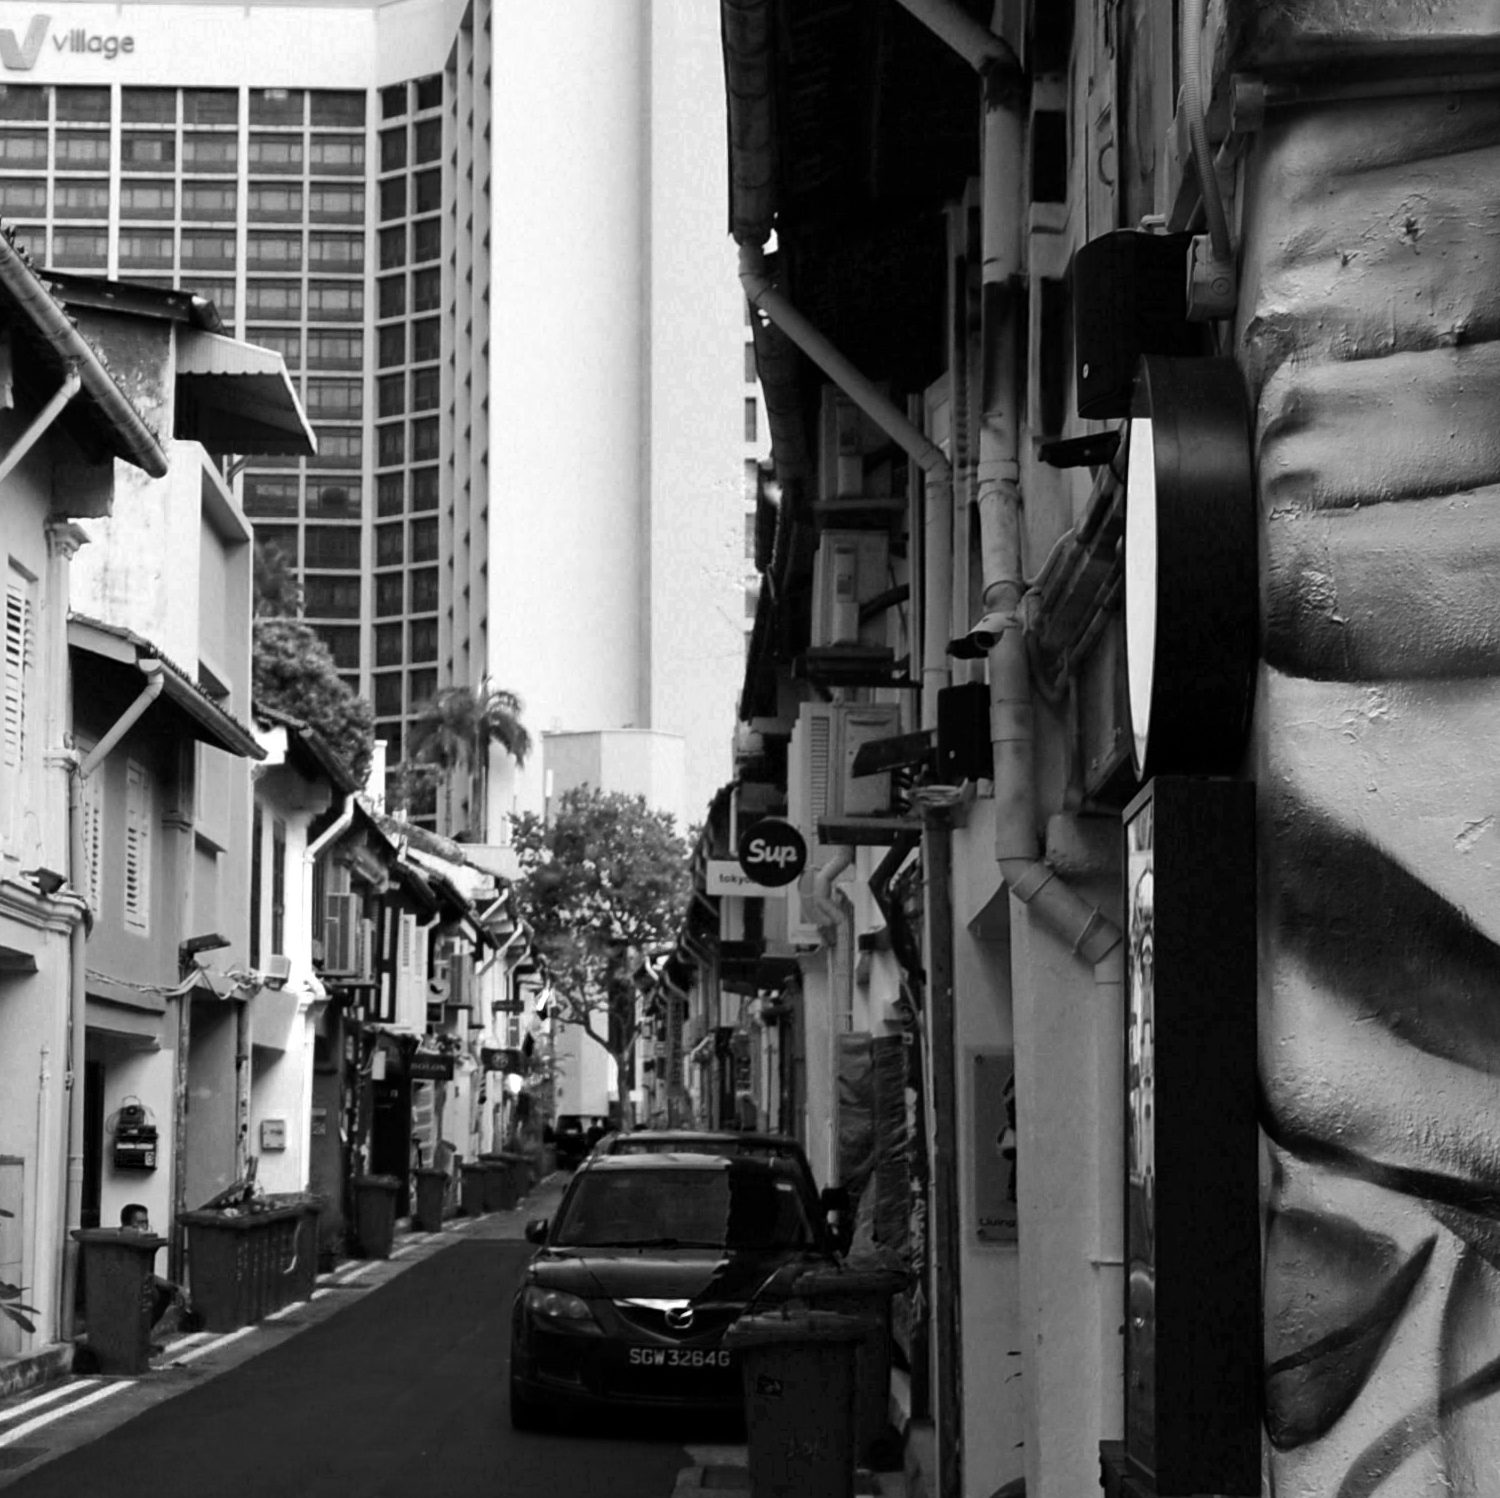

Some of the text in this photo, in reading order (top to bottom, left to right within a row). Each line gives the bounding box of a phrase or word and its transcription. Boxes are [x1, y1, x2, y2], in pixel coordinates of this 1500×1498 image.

[52, 29, 135, 60] village
[746, 838, 798, 869] Sup
[629, 1348, 731, 1366] SGW3264G
